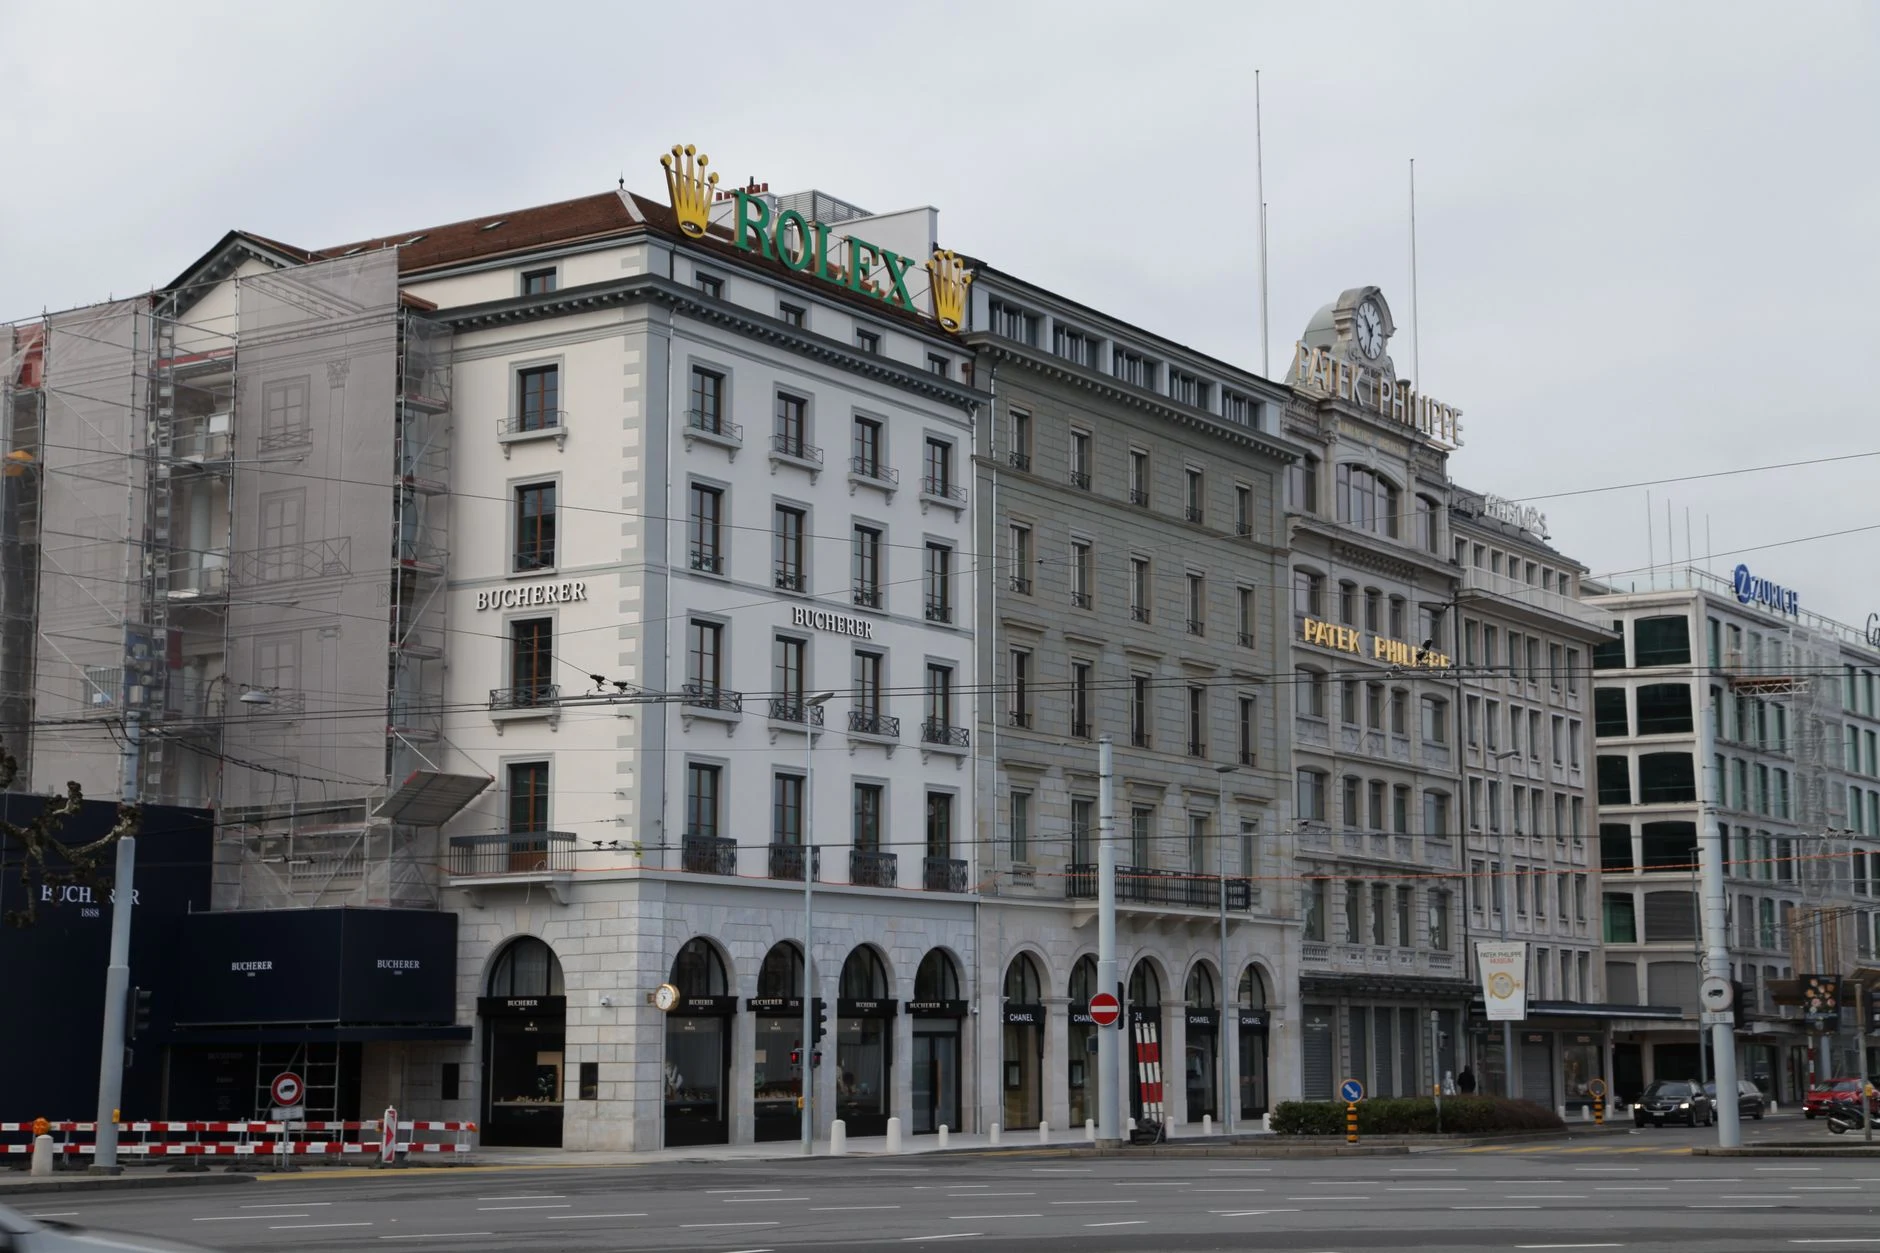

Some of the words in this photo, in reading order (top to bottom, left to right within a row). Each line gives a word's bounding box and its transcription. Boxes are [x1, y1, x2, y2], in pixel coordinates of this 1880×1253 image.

[731, 188, 918, 313] ROLEX
[1296, 340, 1364, 407] PATEK
[1377, 373, 1465, 447] PHILIPPE
[476, 581, 587, 612] BUCHERER
[1750, 576, 1799, 616] ZURICH
[793, 606, 873, 639] BUCHERER
[1304, 617, 1361, 653] PATEK
[81, 908, 100, 918] 1888
[231, 961, 273, 971] BUCHERER
[377, 959, 420, 969] BUCHERER
[507, 999, 538, 1007] BUCHERER
[1009, 1013, 1034, 1022] CHANEL
[1073, 1014, 1092, 1022] CHANE
[1189, 1015, 1210, 1024] CHANEL
[1241, 1017, 1261, 1025] CHANEL
